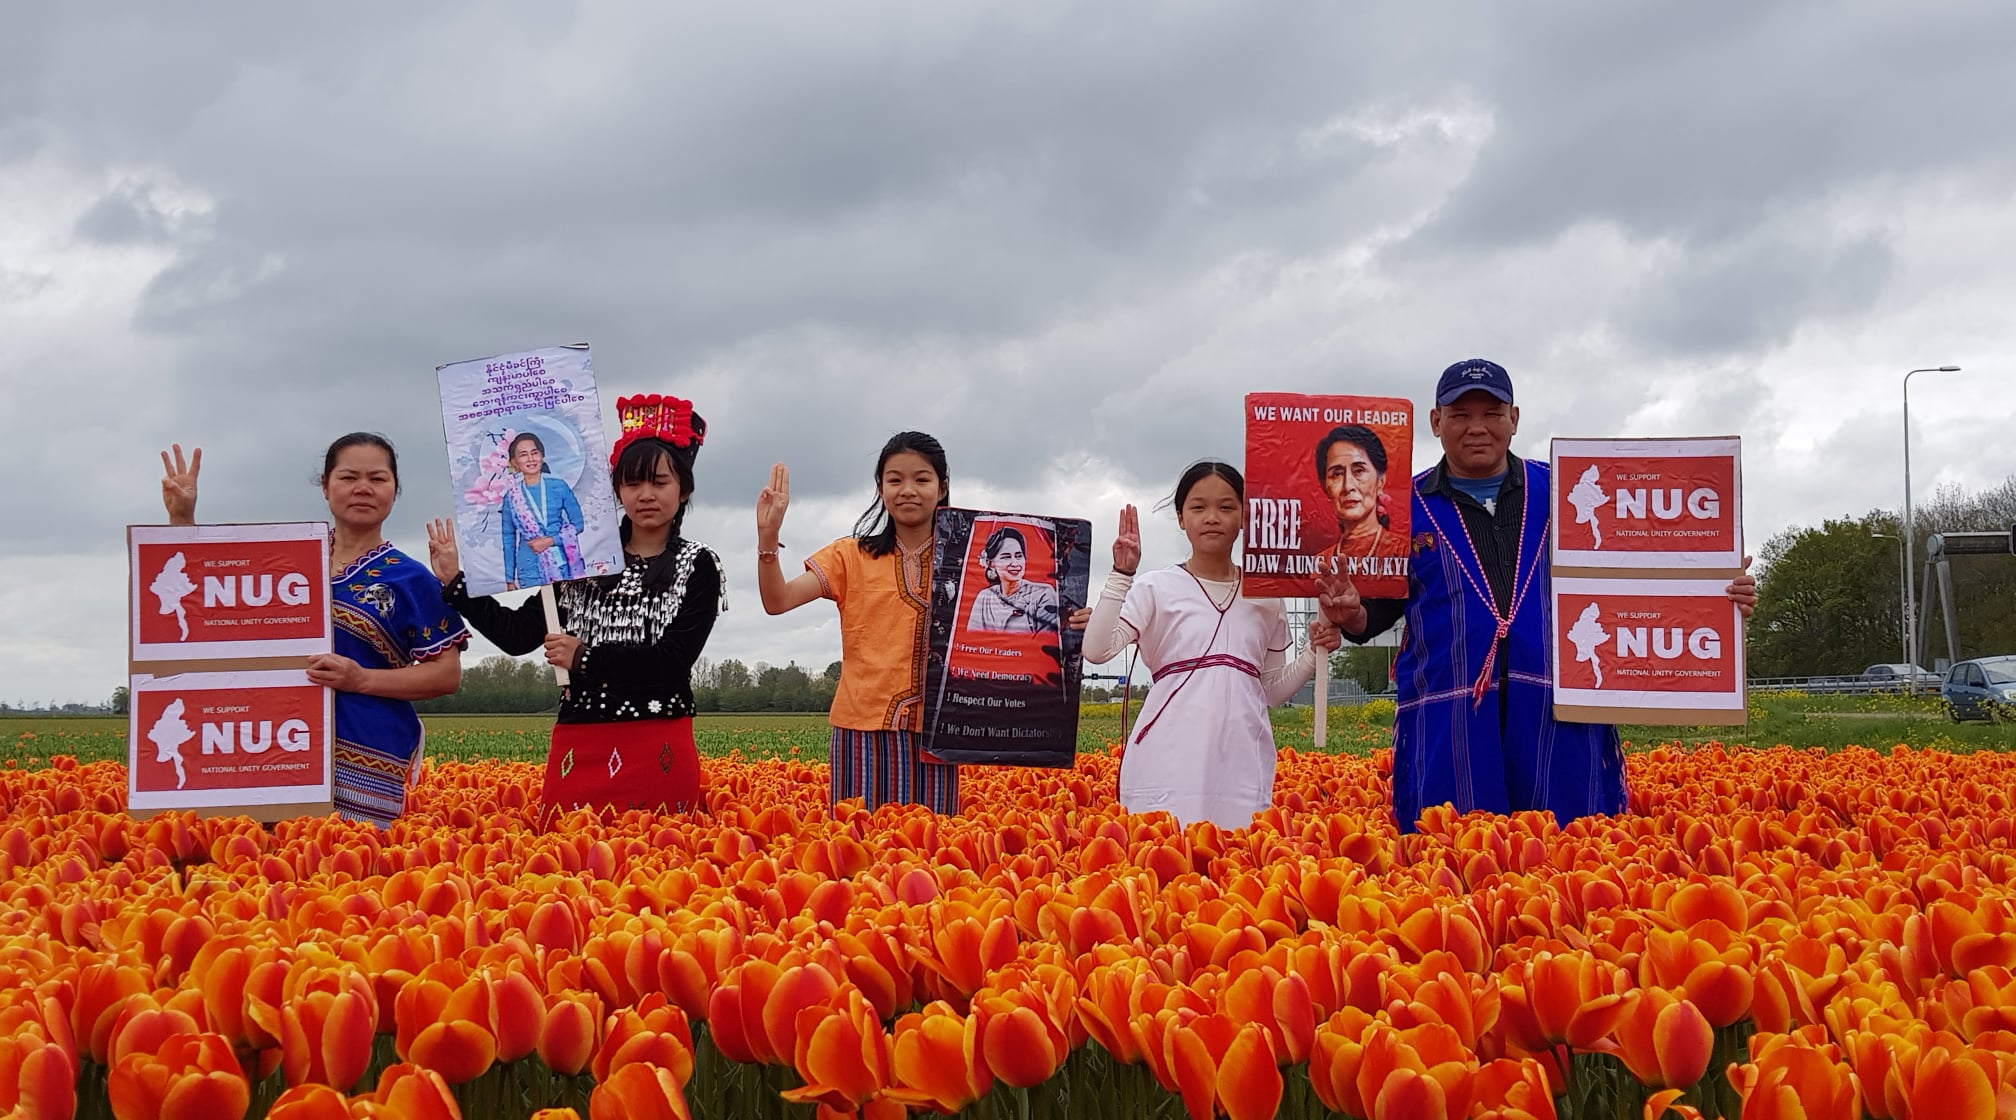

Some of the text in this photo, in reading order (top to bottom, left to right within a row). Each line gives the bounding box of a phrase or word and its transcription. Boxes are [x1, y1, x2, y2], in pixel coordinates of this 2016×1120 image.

[1254, 406, 1408, 426] WE WANT OUR LEADER
[1616, 487, 1720, 520] NUG
[1248, 498, 1301, 550] FREE
[1245, 553, 1280, 574] DAW
[1330, 555, 1358, 576] SN
[1361, 556, 1379, 576] SU
[1383, 556, 1408, 577] KYI
[203, 572, 311, 608] NUG
[204, 616, 311, 626] NATIONAL UNITY GOVERNMENT
[960, 643, 977, 653] Free
[979, 645, 993, 654] Our
[994, 646, 1023, 657] Leaders
[1616, 626, 1721, 660] NUG
[957, 667, 969, 676] We
[971, 669, 989, 679] Need
[991, 671, 1033, 683] Democracy
[1651, 669, 1673, 677] UNITY
[952, 692, 985, 706] Respect
[987, 697, 1002, 707] Our
[1004, 698, 1026, 708] Votes
[203, 705, 250, 714] WE SUPPORT
[201, 718, 311, 755] NUG
[947, 723, 960, 735] We
[962, 725, 985, 737] Don't
[987, 726, 1009, 738] Want
[201, 766, 237, 774] NATIONAL
[262, 763, 311, 772] GOVERNMENT
